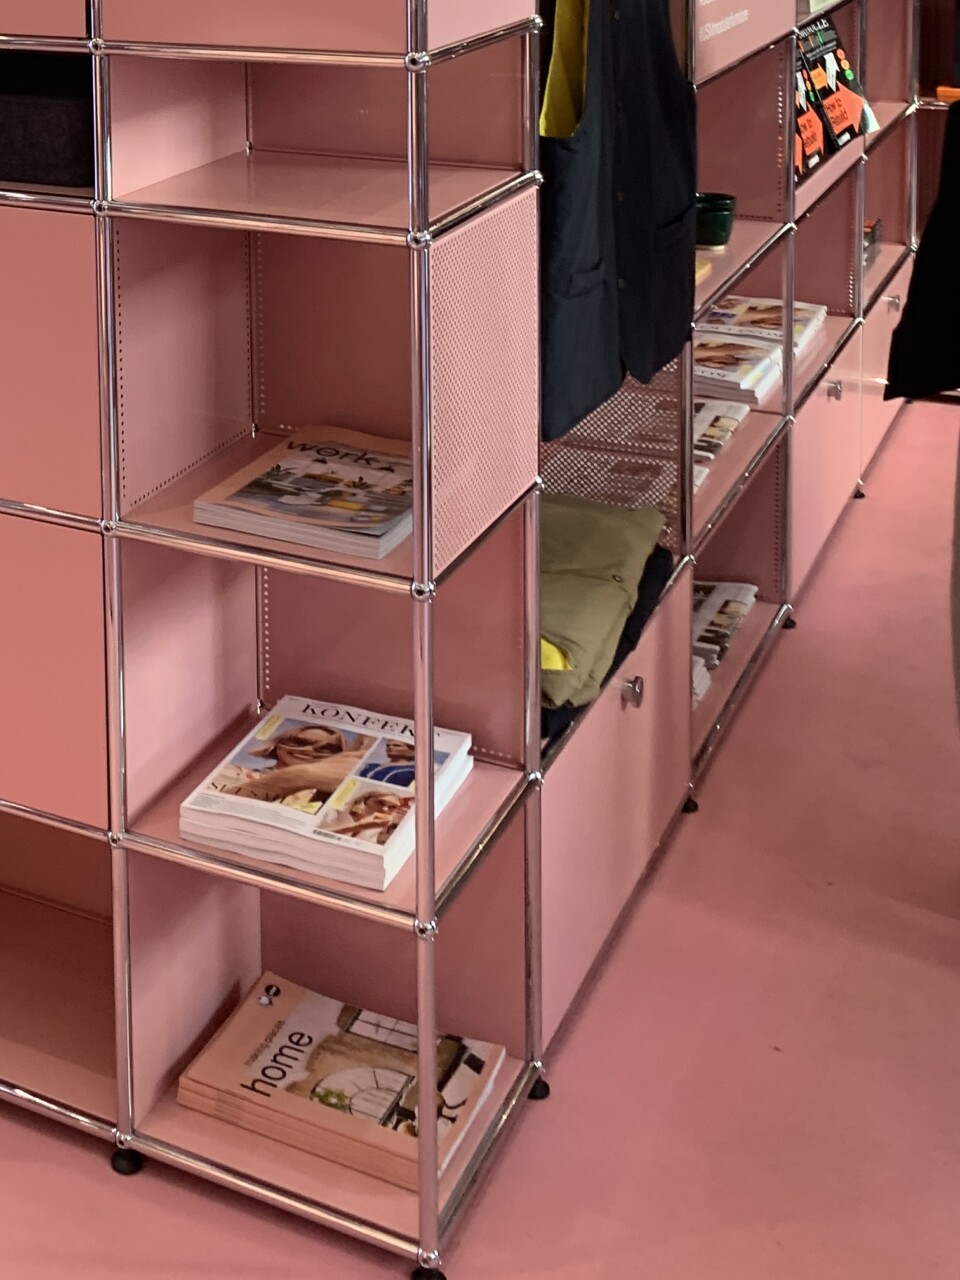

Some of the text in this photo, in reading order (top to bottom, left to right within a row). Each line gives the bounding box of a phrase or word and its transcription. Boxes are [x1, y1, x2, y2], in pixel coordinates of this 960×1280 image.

[286, 440, 379, 467] work
[300, 703, 440, 739] KONFEK
[240, 1031, 314, 1098] home
